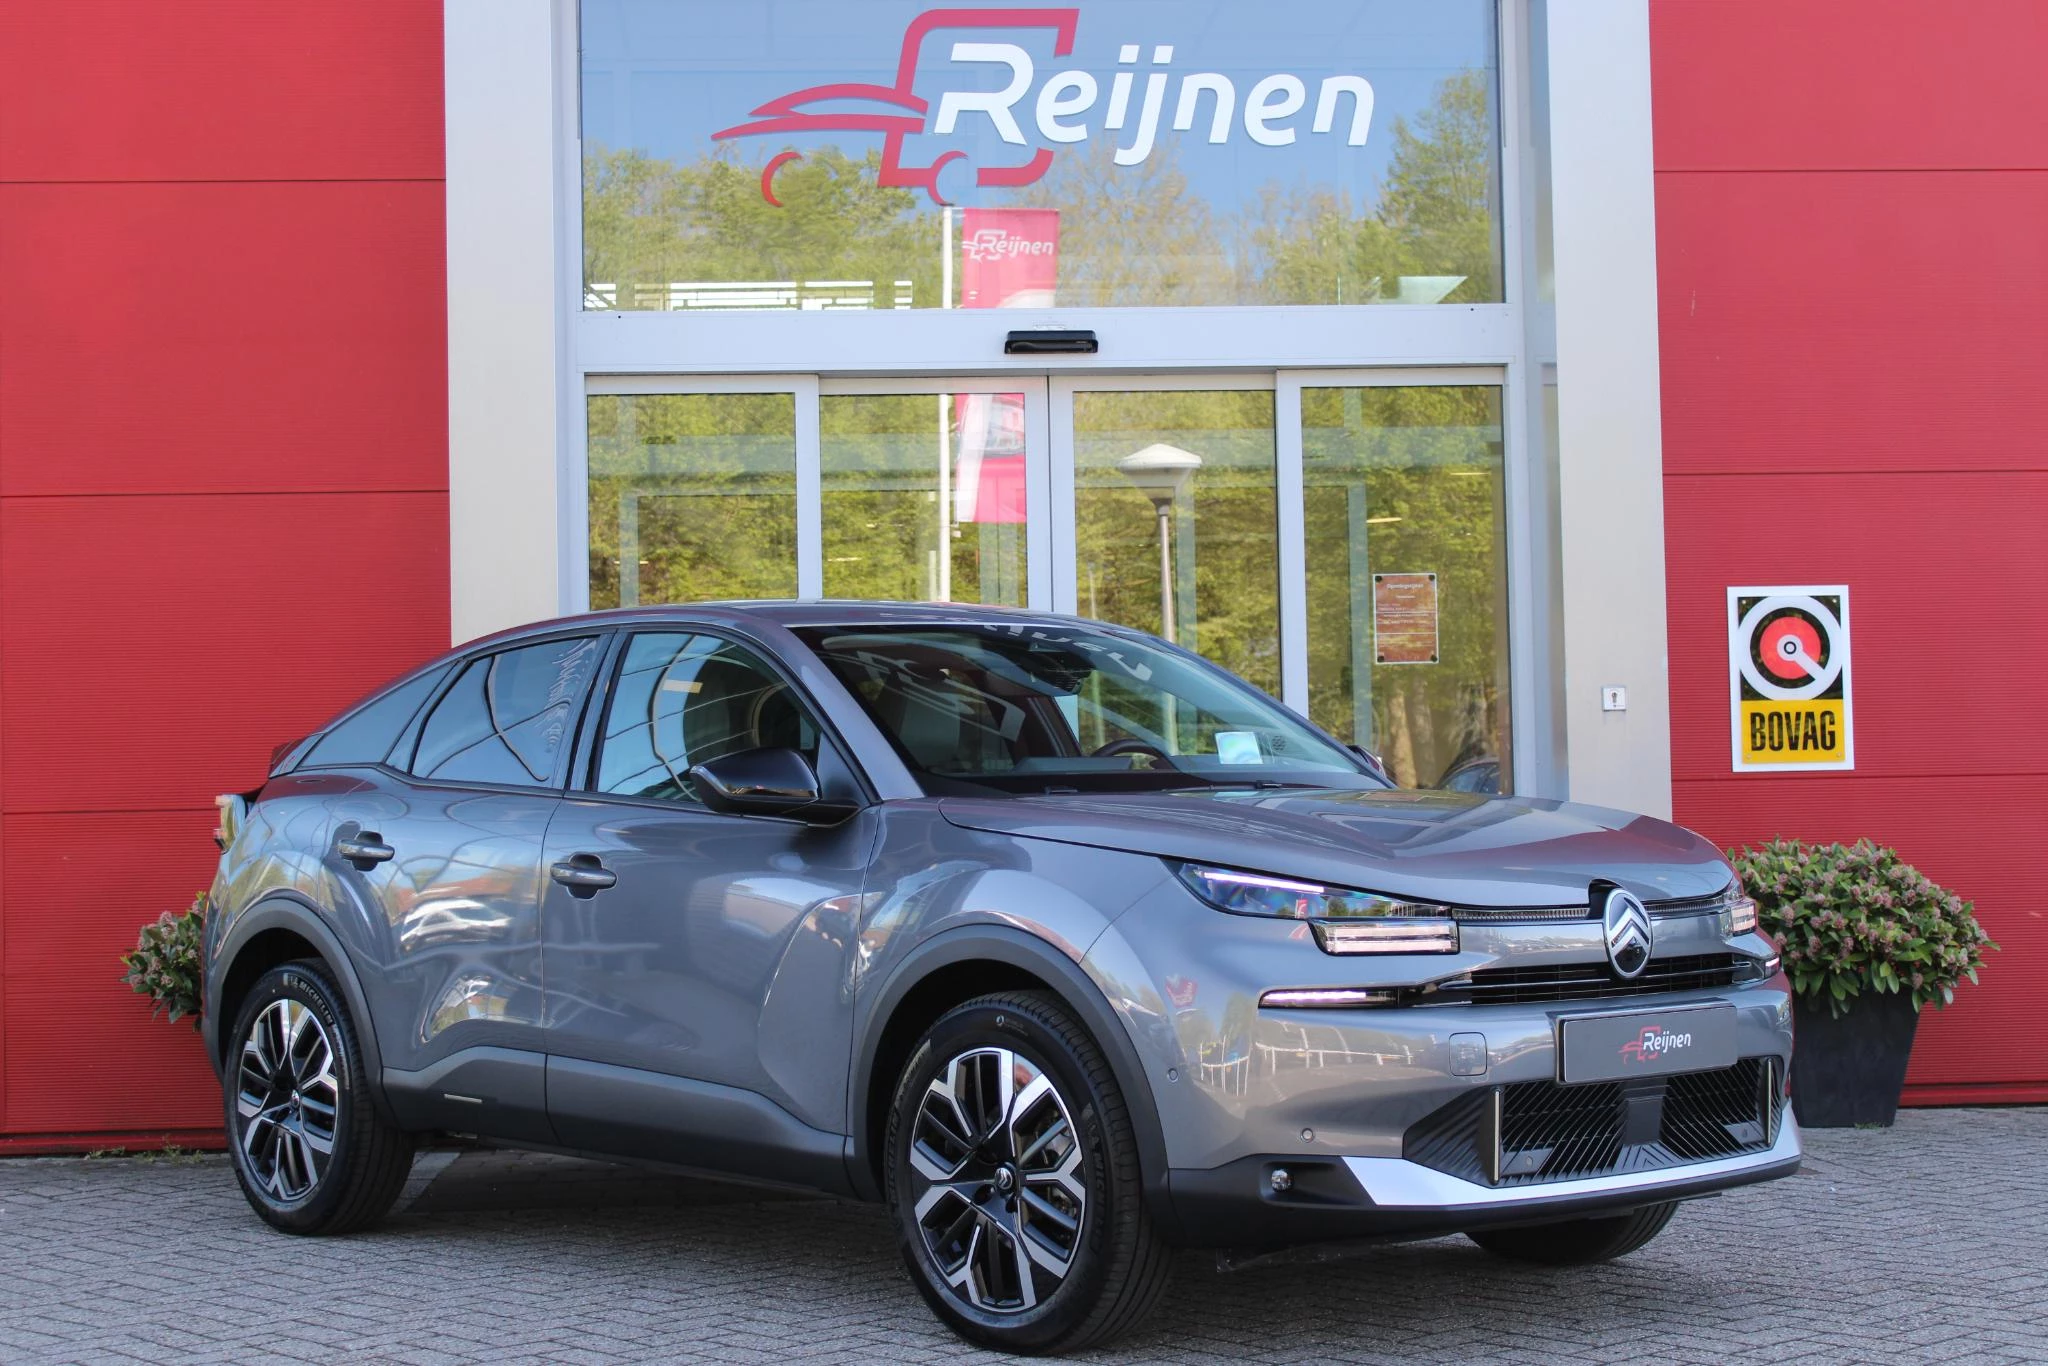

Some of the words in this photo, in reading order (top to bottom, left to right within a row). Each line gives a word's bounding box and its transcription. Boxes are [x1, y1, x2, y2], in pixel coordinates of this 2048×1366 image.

[934, 42, 1375, 167] Reijnen
[980, 235, 1054, 258] Reijnen
[1750, 710, 1836, 752] BOVAG
[299, 981, 334, 1027] MICHELIN
[1643, 1030, 1691, 1053] Reijnen
